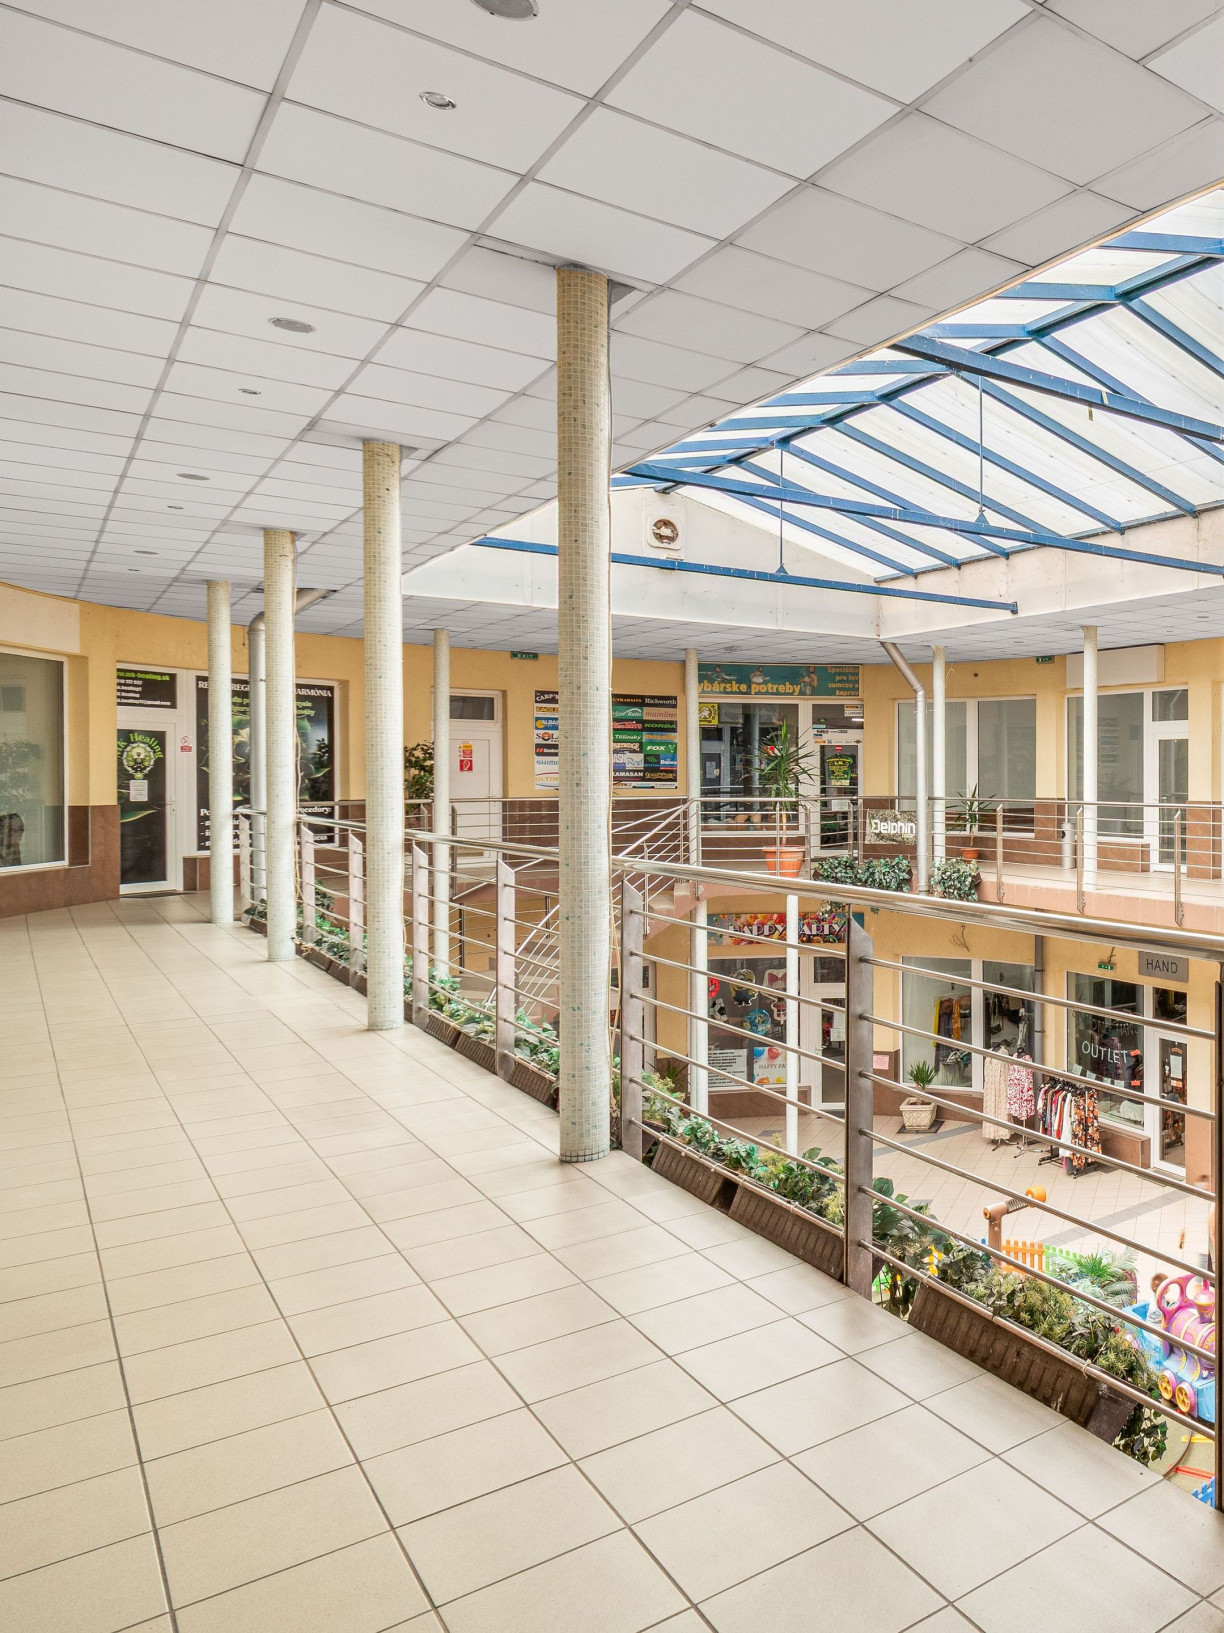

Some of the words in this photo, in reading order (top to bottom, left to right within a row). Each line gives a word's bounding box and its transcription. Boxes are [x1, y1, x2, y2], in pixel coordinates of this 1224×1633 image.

[295, 687, 332, 697] ARMÓNIA
[698, 680, 747, 694] ybárske
[751, 682, 800, 695] potreby
[129, 733, 164, 759] Healing
[870, 819, 916, 836] Delphin
[729, 923, 786, 937] HAPPY
[798, 923, 845, 936] ARTY
[1146, 957, 1179, 974] HAND
[1081, 1040, 1128, 1064] OUTLET
